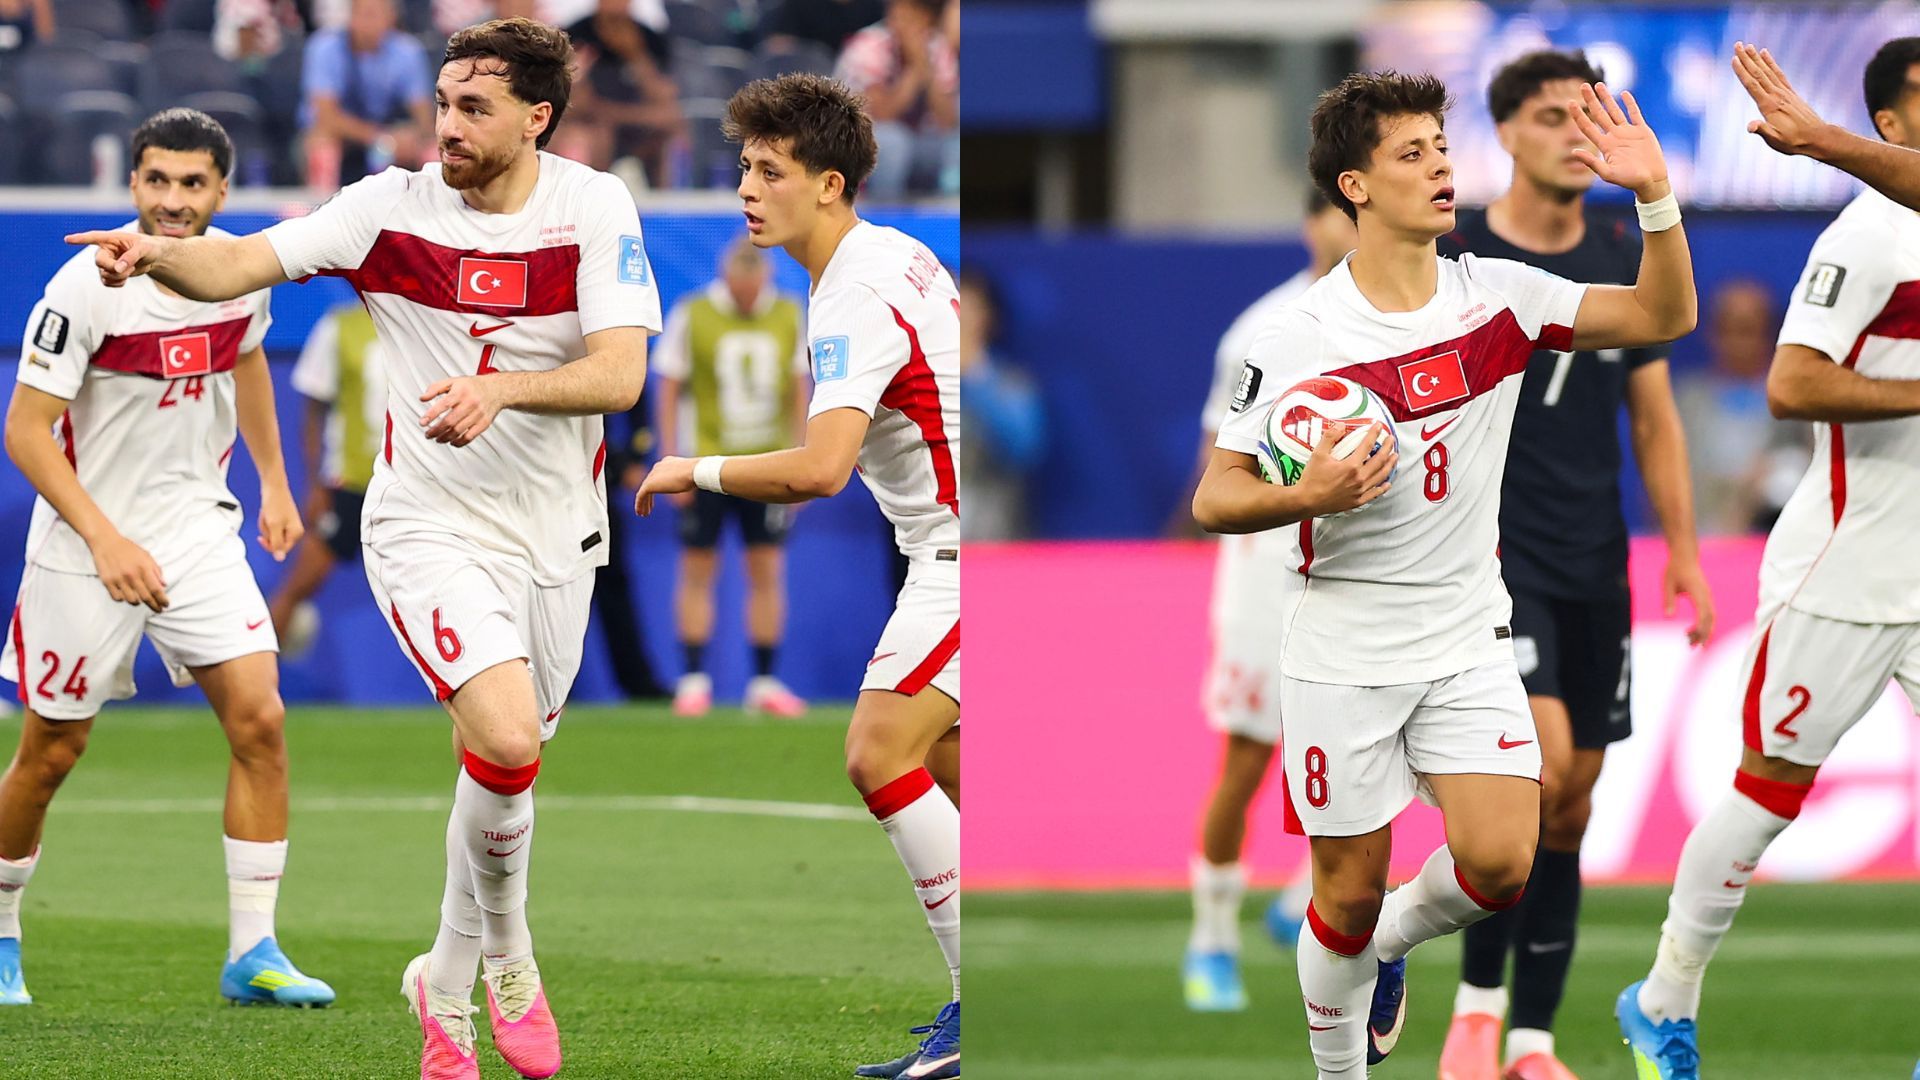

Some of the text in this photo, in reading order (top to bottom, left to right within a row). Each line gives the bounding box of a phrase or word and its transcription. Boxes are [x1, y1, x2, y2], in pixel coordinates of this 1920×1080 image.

[158, 376, 206, 409] 24
[1423, 441, 1451, 504] 8
[432, 606, 466, 663] 6
[36, 650, 88, 701] 24
[1773, 684, 1812, 740] 2
[1305, 745, 1331, 811] 8
[1303, 994, 1343, 1017] RKİYE
